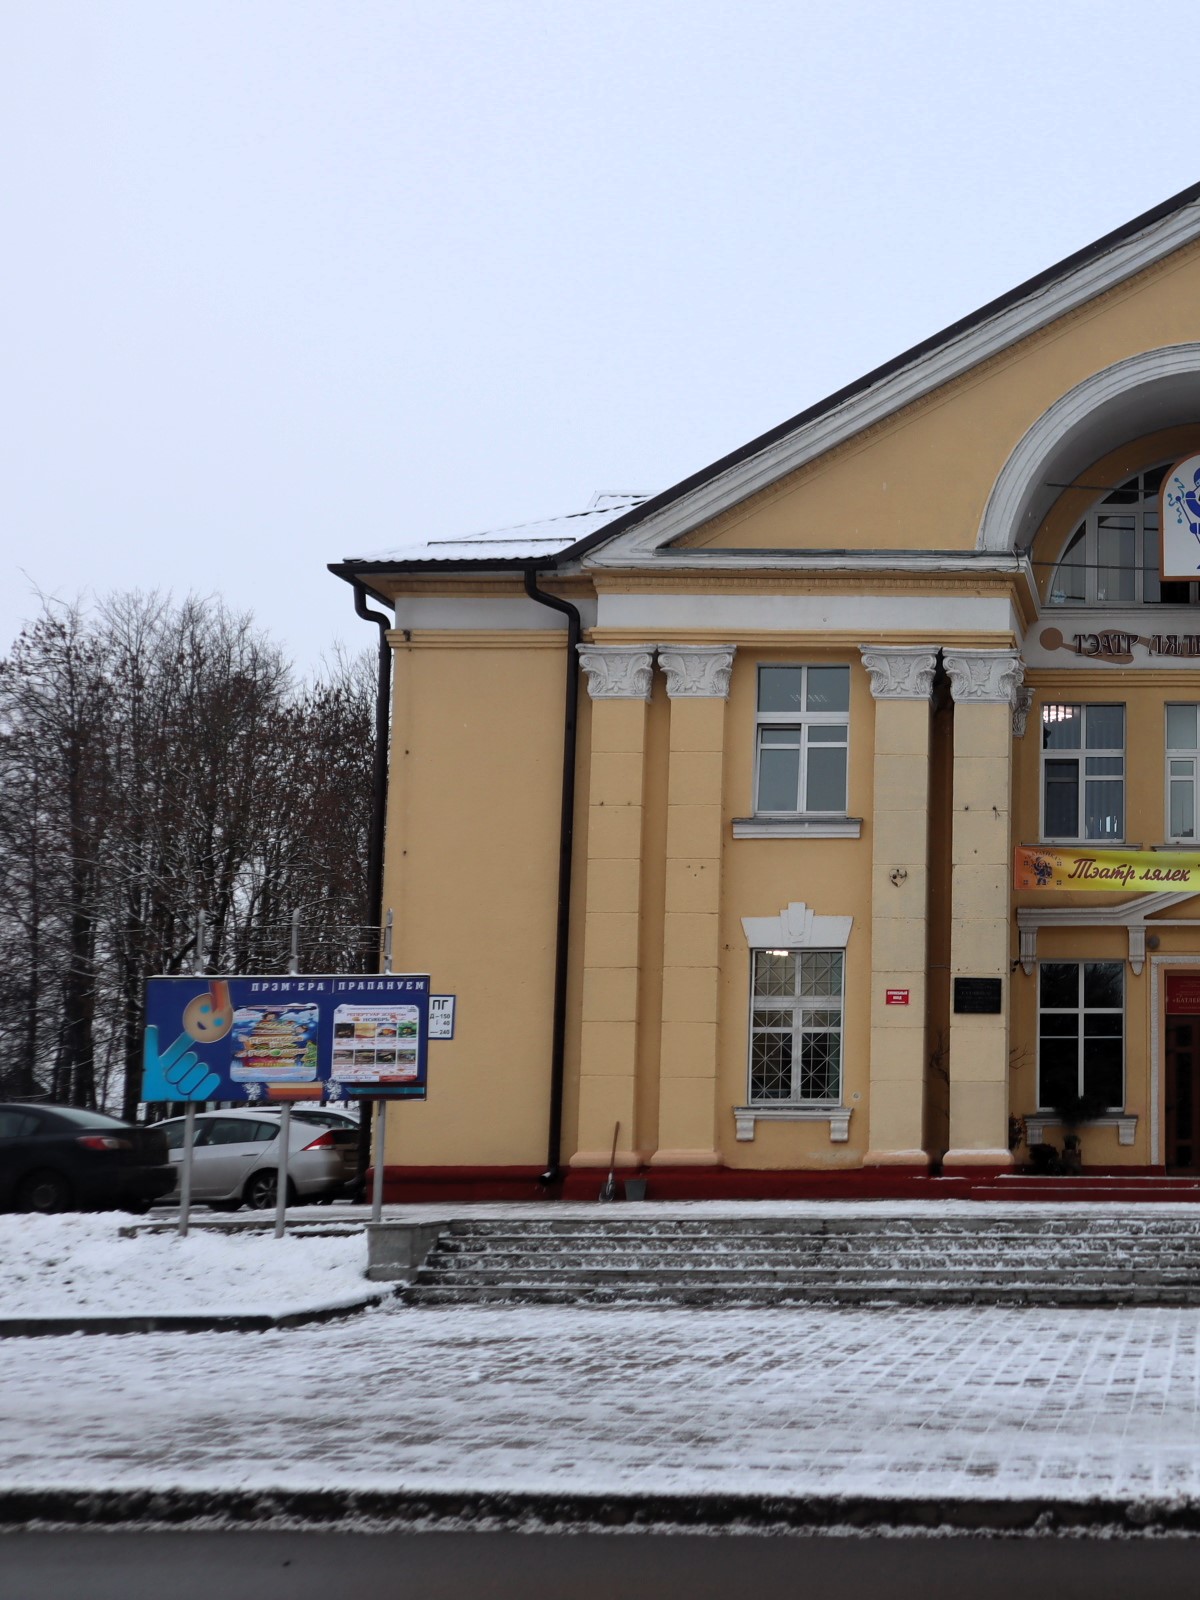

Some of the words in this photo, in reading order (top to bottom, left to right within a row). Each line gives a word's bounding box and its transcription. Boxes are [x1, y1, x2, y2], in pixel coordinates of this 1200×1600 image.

[1073, 633, 1139, 657] ТЭАТР
[1068, 858, 1136, 886] Тэатр
[1139, 867, 1191, 882] лялек
[251, 982, 324, 992] ПРЭМ'ЕРА
[338, 981, 424, 991] ПРАПАНУЕМ
[432, 999, 449, 1010] ПГ
